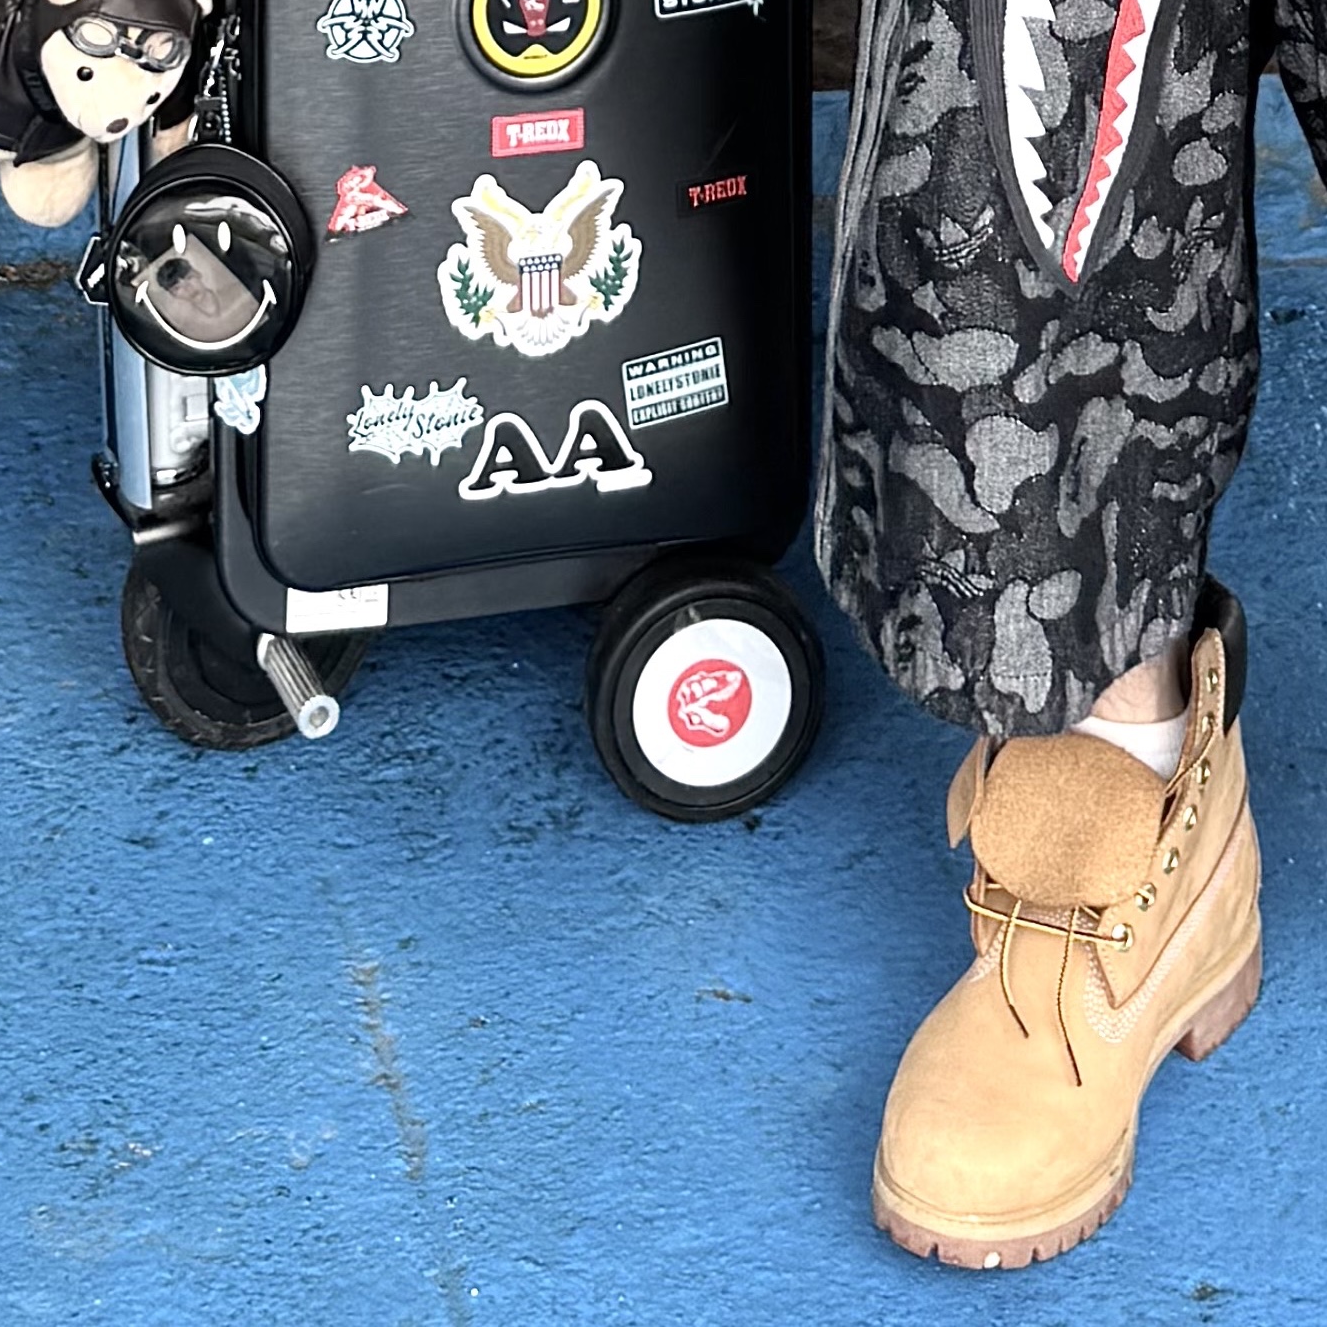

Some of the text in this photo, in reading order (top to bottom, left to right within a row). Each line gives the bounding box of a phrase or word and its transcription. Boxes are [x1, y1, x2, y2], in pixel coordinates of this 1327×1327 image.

[627, 344, 718, 378] WARNING
[629, 363, 722, 402] LONELYSTONIE
[353, 401, 479, 439] Lonely Stonie
[465, 407, 639, 493] AA
